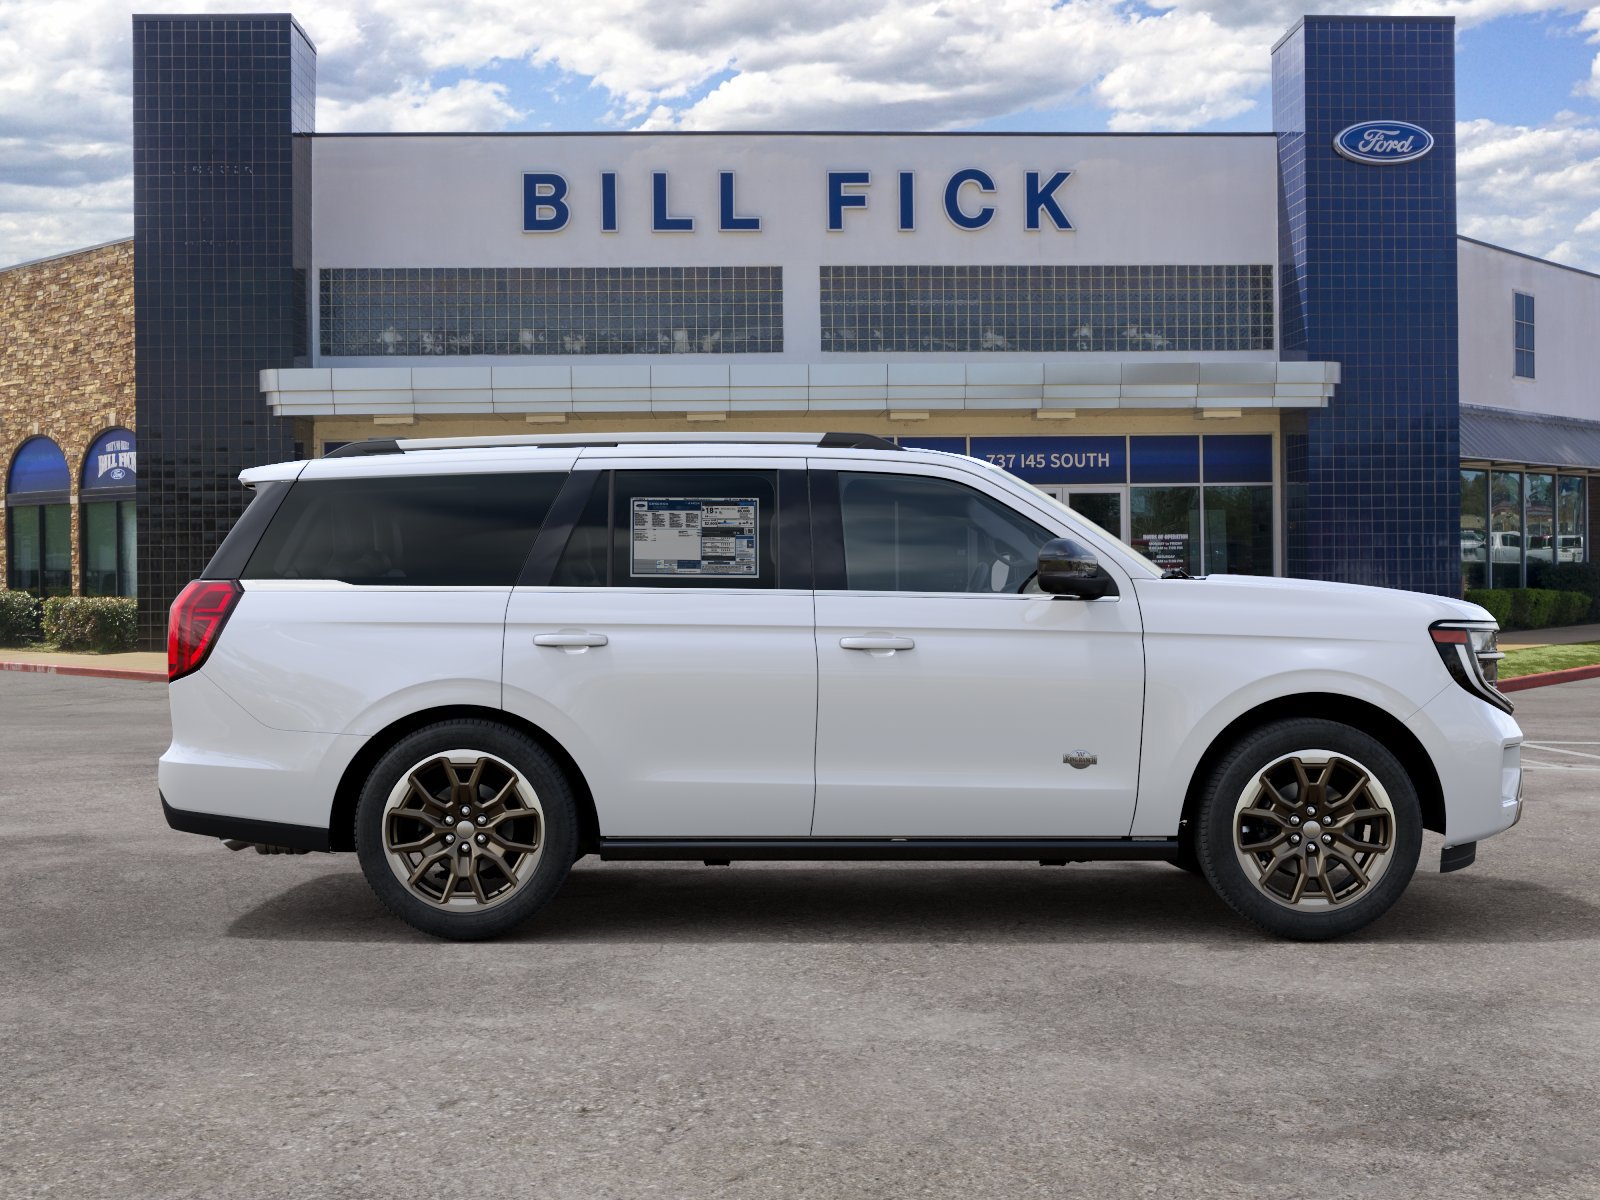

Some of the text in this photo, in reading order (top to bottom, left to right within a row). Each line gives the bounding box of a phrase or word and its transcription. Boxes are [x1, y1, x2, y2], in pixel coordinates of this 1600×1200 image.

[1358, 129, 1415, 153] Ford
[522, 168, 1077, 233] BILL FICK
[98, 452, 136, 478] BILL FICK
[986, 453, 1110, 469] 737 I45 SOUTH
